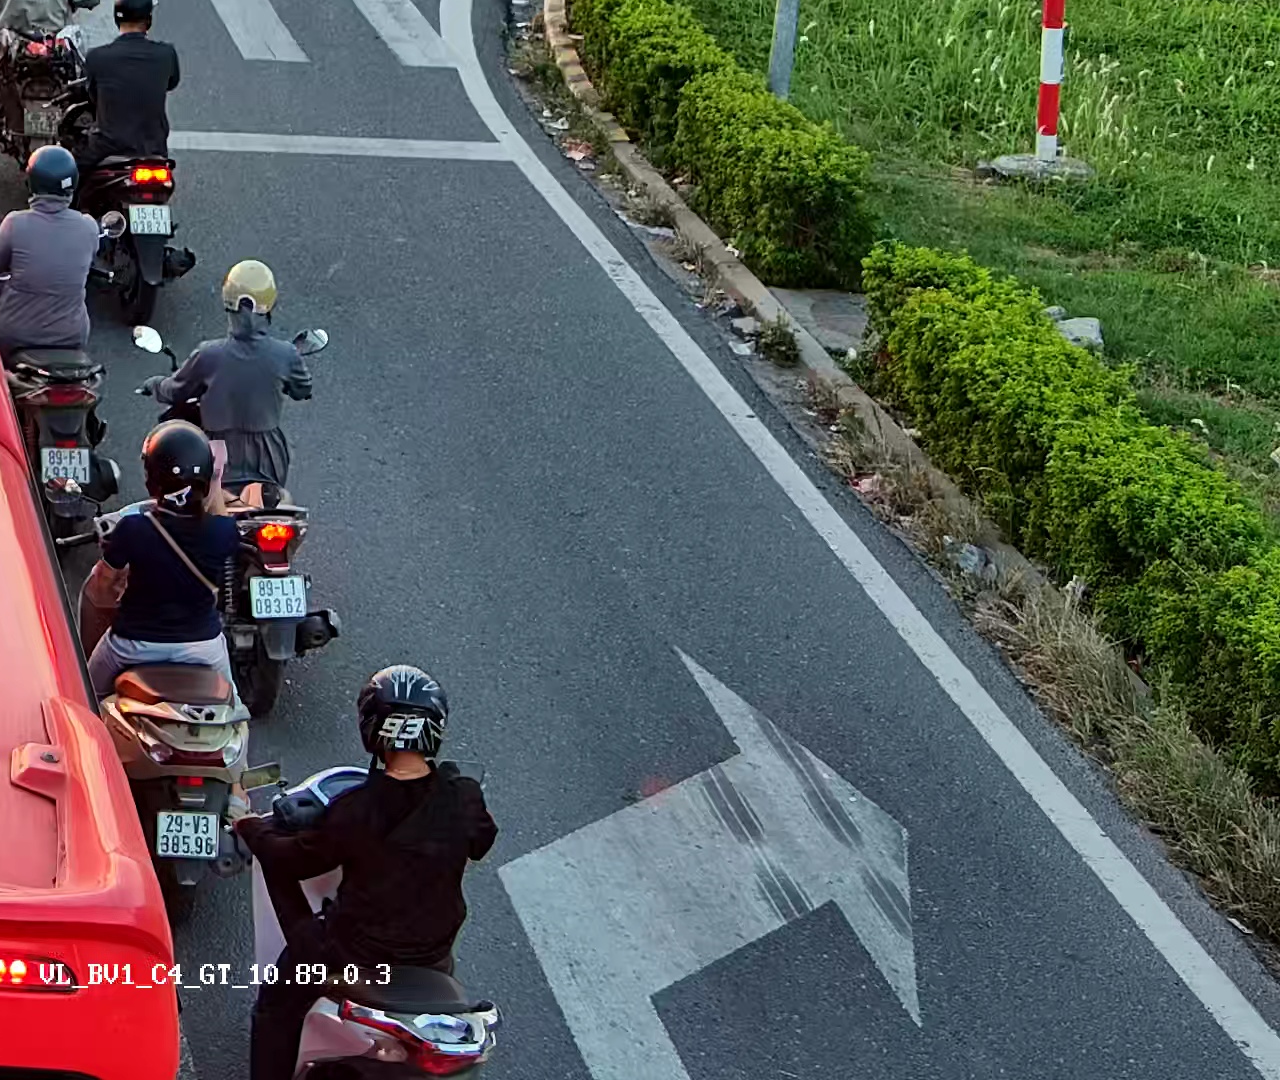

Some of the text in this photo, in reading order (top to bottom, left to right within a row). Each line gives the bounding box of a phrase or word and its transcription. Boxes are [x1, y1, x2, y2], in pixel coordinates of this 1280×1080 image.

[258, 579, 296, 597] 89-L1
[255, 597, 303, 614] 083.62
[378, 717, 425, 739] 93
[165, 814, 209, 834] 29-V3
[160, 834, 214, 856] 385.96
